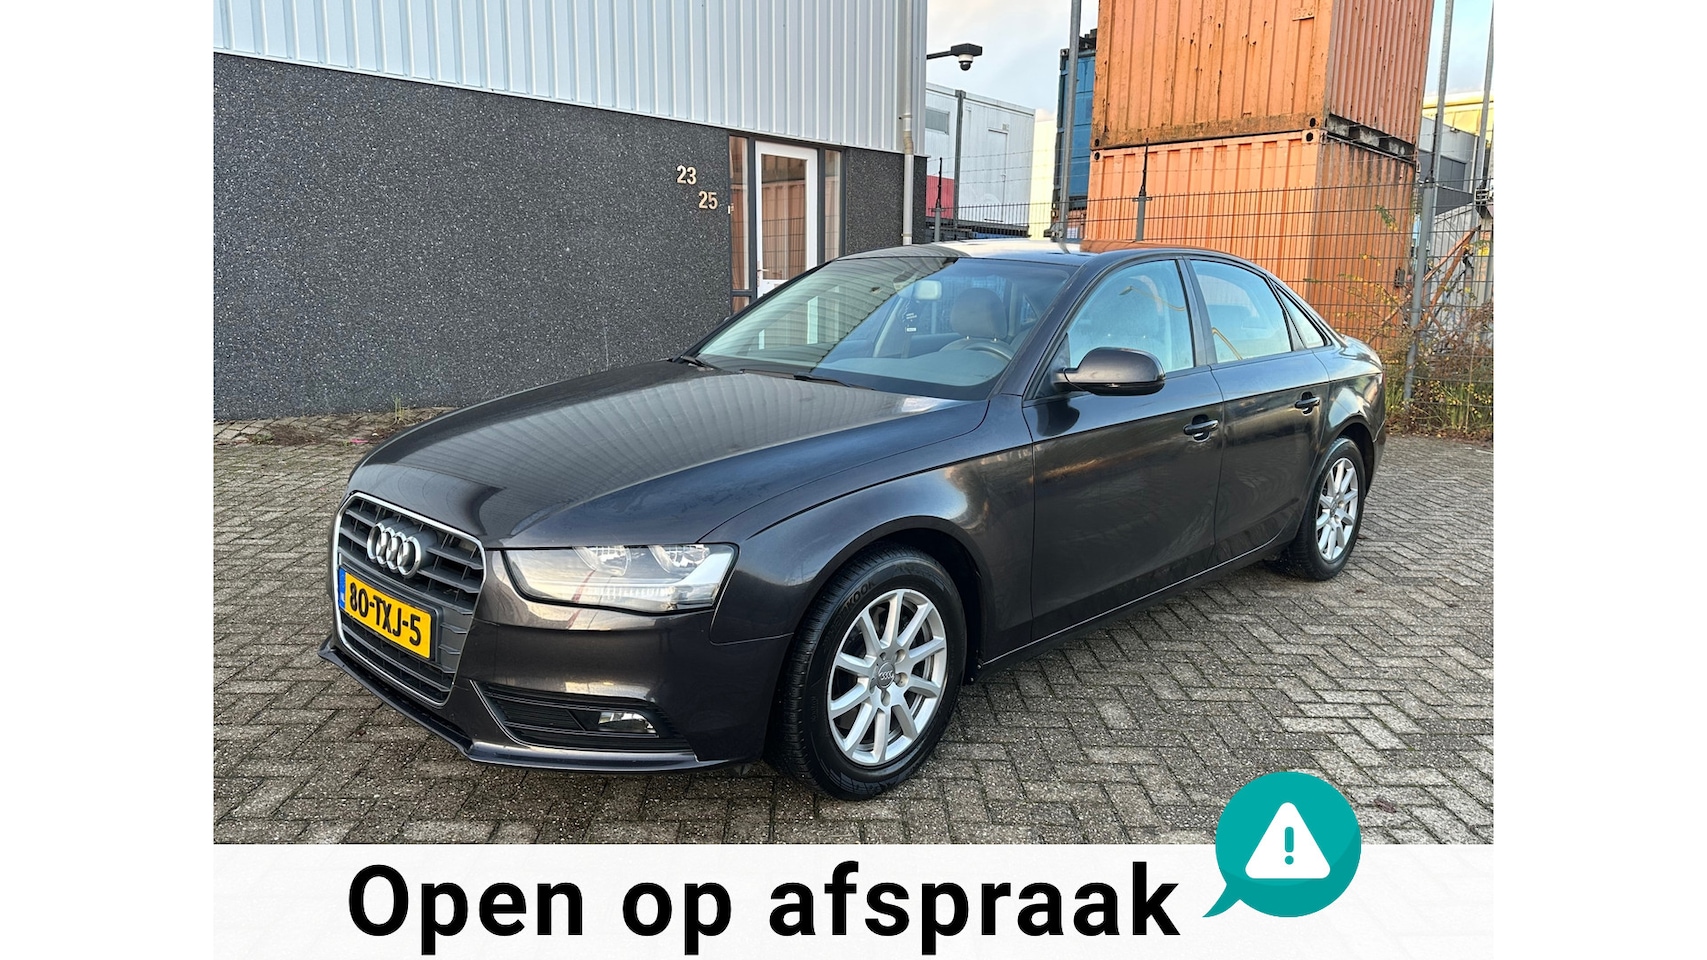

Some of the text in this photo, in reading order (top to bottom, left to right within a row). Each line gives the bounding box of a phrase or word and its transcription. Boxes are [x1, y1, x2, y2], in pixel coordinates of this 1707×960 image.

[676, 164, 697, 185] 23
[698, 190, 718, 210] 25
[349, 582, 421, 647] 80-TXJ-5
